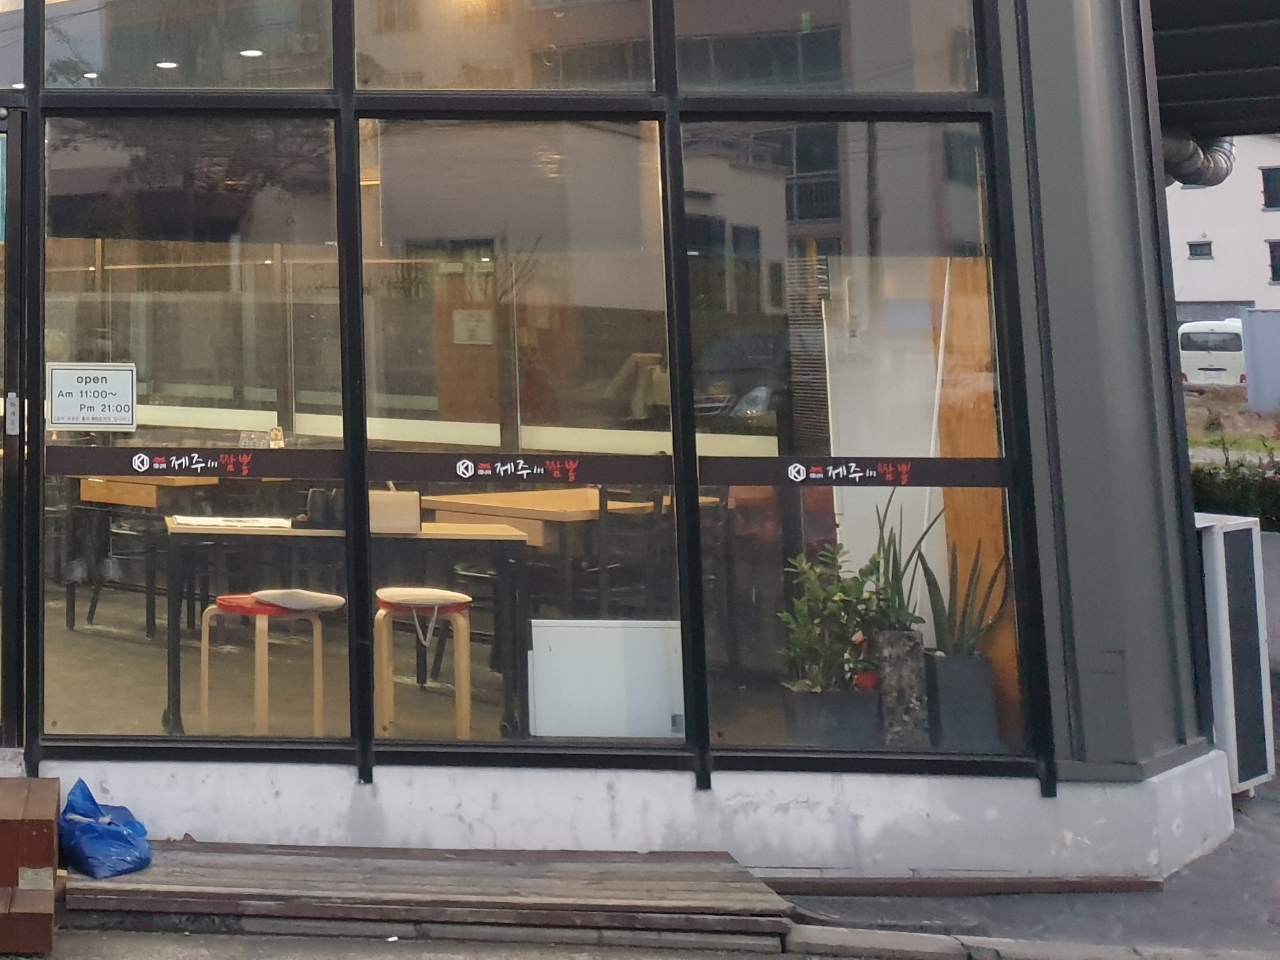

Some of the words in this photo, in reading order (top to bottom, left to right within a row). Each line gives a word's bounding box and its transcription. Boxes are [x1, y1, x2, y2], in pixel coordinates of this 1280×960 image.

[76, 376, 108, 385] open
[57, 390, 73, 398] Am
[79, 404, 95, 412] Pm
[100, 404, 131, 413] 21:00
